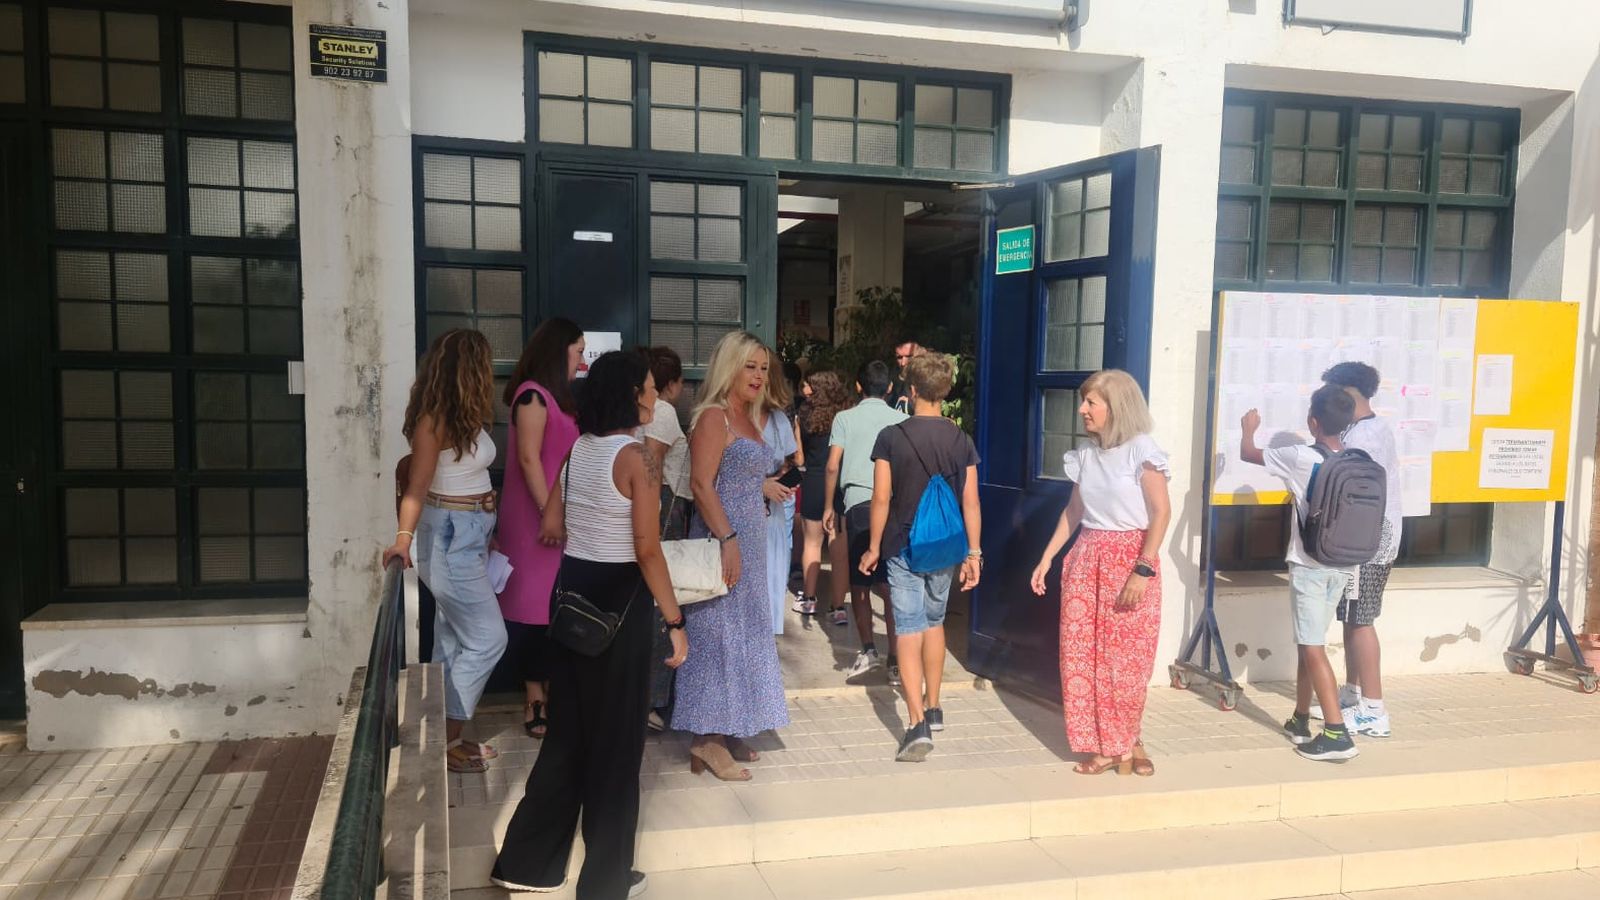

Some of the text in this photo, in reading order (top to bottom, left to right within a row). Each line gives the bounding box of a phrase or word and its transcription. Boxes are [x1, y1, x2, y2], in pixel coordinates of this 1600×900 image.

[323, 42, 374, 54] STANLEY
[322, 56, 376, 67] Security Solutions
[324, 66, 338, 75] 902
[340, 68, 351, 76] 23
[365, 70, 374, 78] 87
[1002, 238, 1030, 251] SALIDA DE
[1000, 251, 1033, 263] EMERGENCIA
